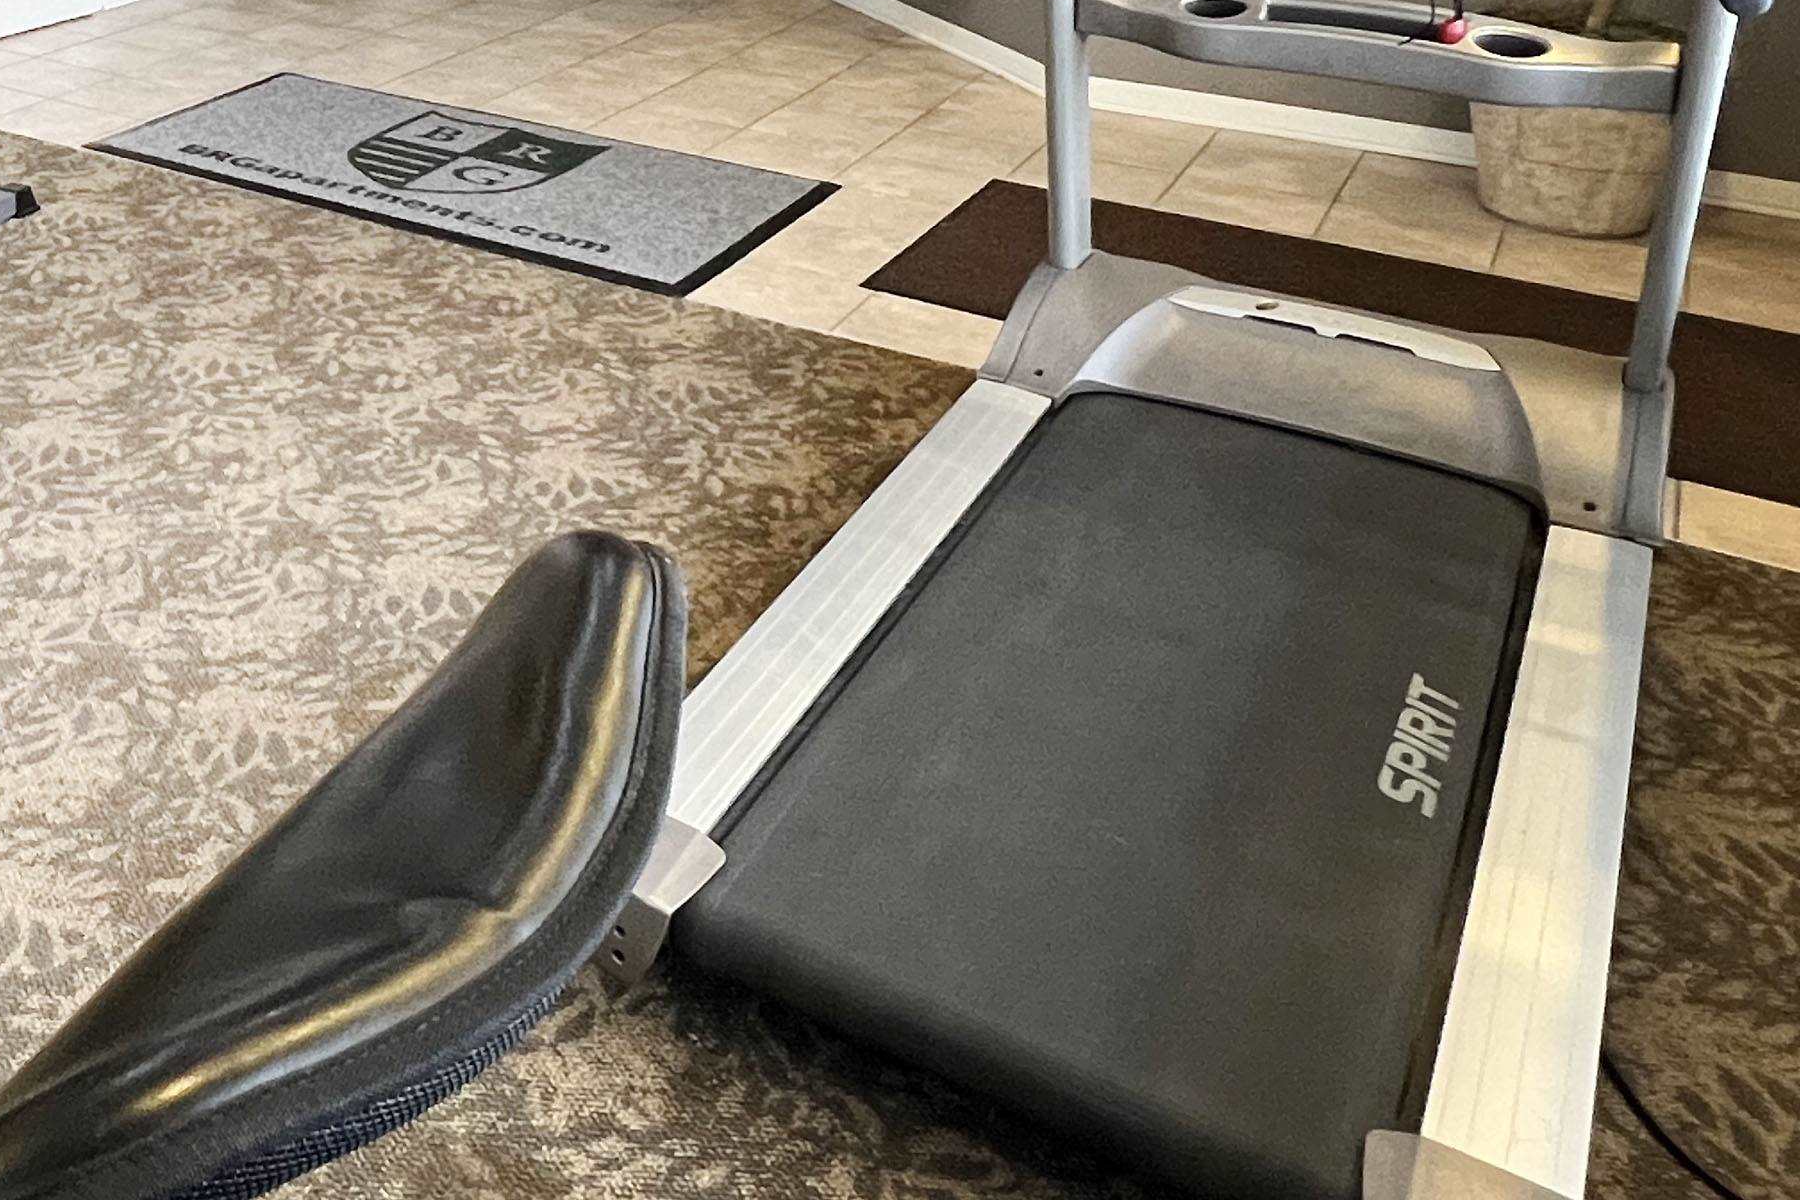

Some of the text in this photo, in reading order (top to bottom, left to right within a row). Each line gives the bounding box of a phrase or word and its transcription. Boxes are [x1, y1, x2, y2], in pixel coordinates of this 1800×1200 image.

[415, 126, 463, 141] B
[504, 143, 551, 163] R
[452, 166, 510, 185] G
[178, 144, 611, 253] BRGapartments.com
[1377, 672, 1462, 818] SPIRIT
